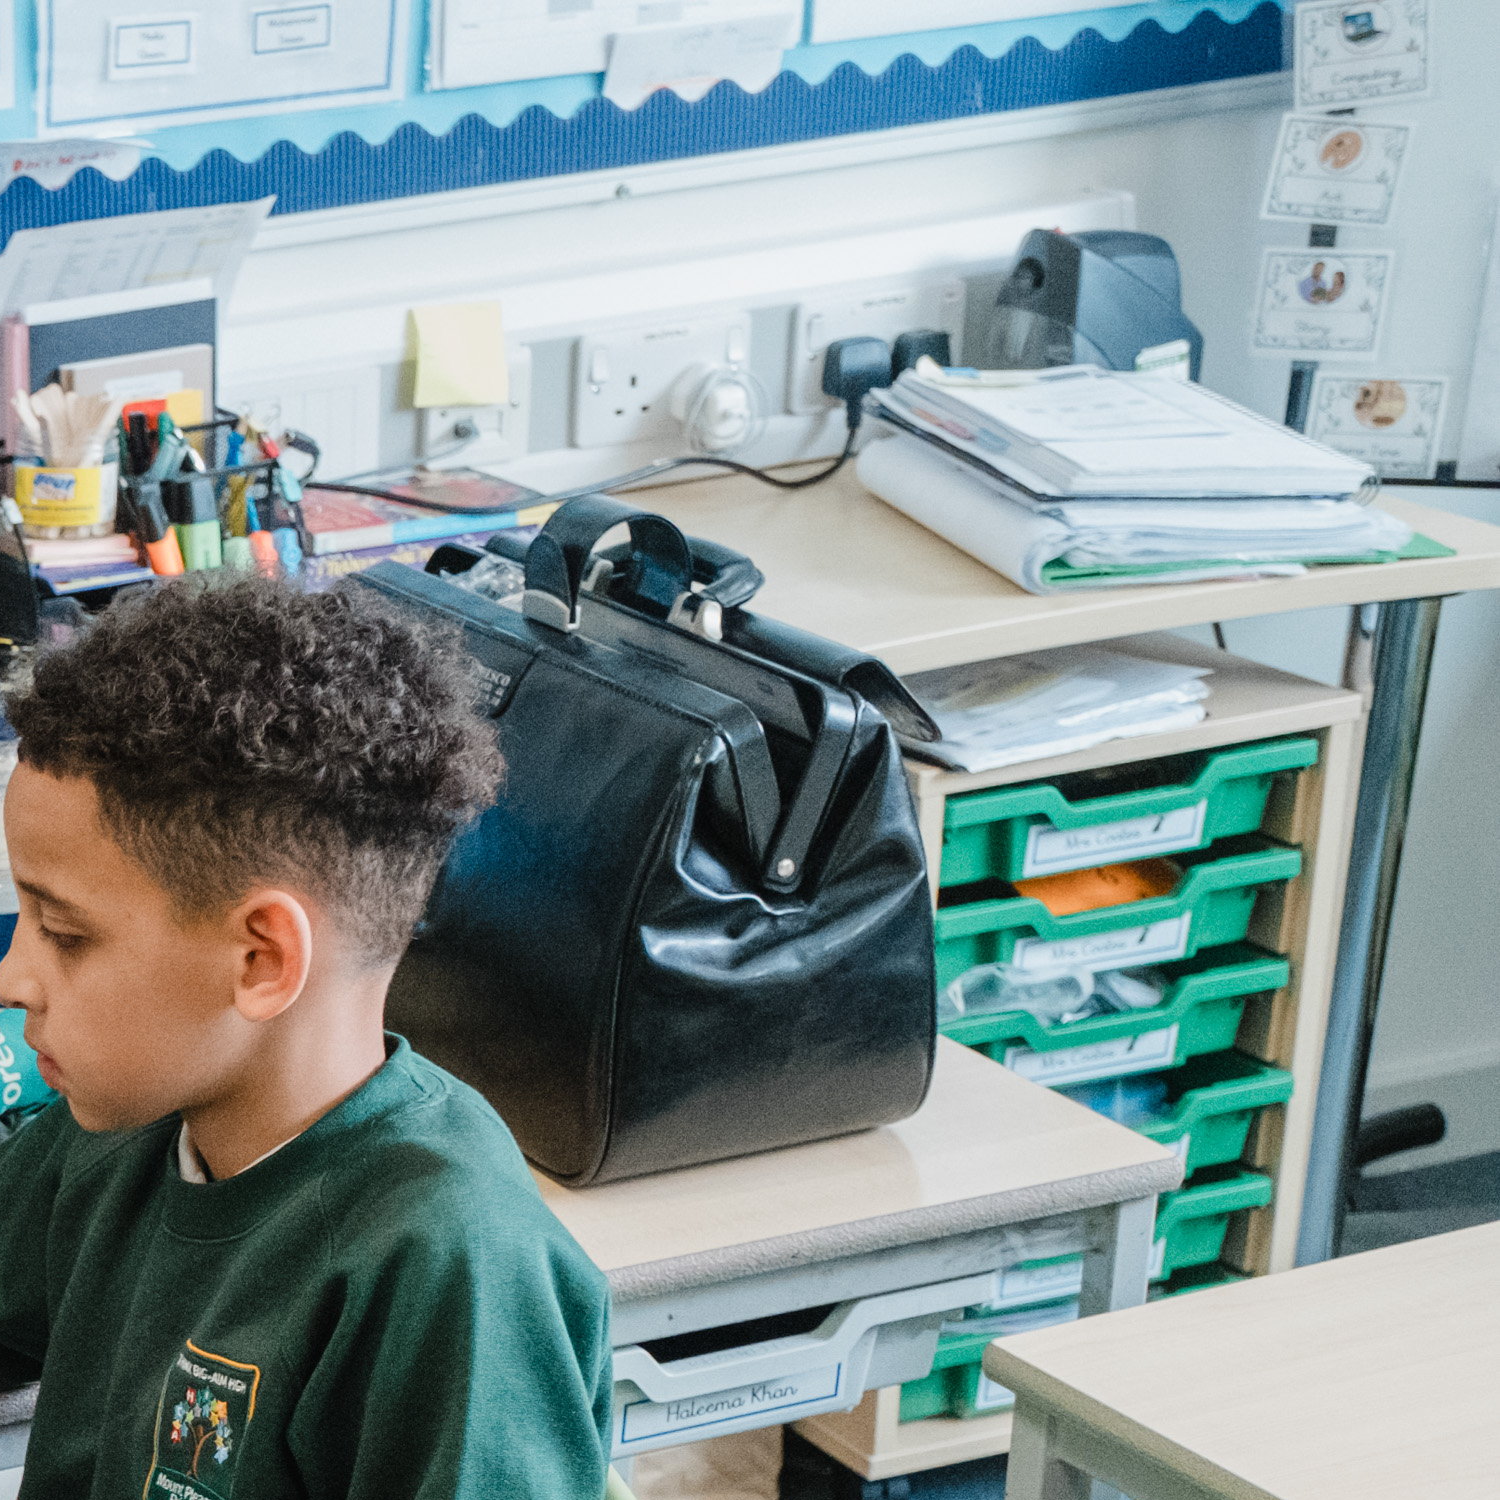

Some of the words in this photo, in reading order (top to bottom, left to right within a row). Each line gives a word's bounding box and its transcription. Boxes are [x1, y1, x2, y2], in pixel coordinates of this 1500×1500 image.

[665, 1397, 745, 1423] Haleema
[750, 1383, 799, 1404] Khan
[155, 1472, 185, 1497] Mount
